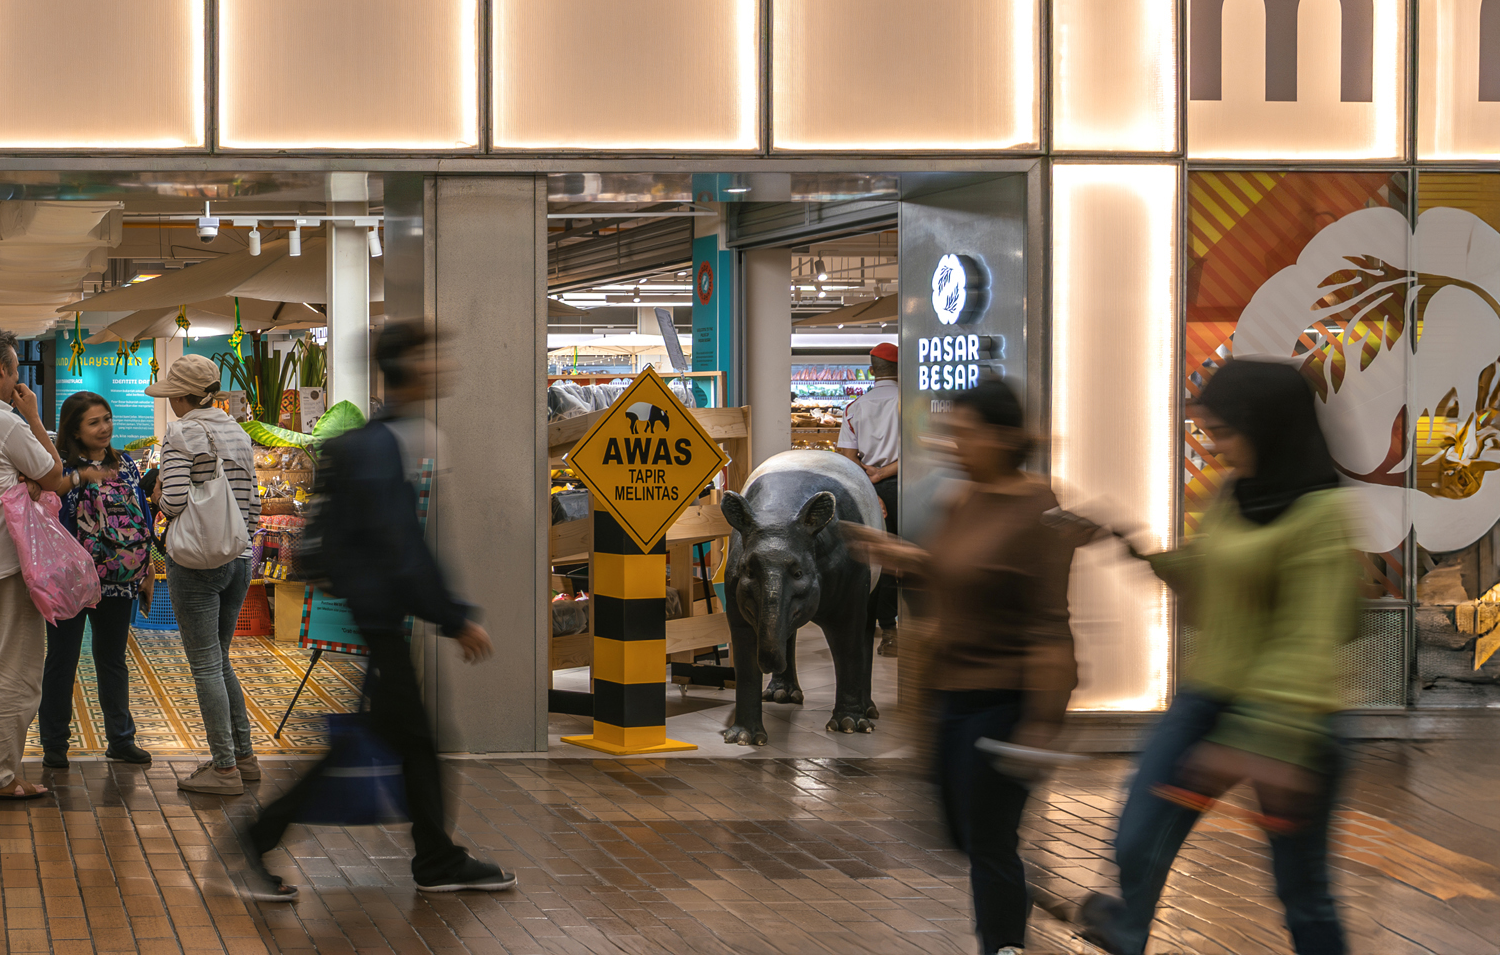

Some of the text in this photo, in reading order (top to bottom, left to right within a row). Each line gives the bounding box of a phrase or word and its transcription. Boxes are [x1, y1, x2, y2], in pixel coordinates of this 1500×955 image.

[918, 334, 980, 363] PASAR
[918, 364, 980, 391] BESAR
[602, 437, 693, 466] AWAS
[628, 469, 667, 484] TAPIR
[614, 486, 680, 501] MELINTAS
